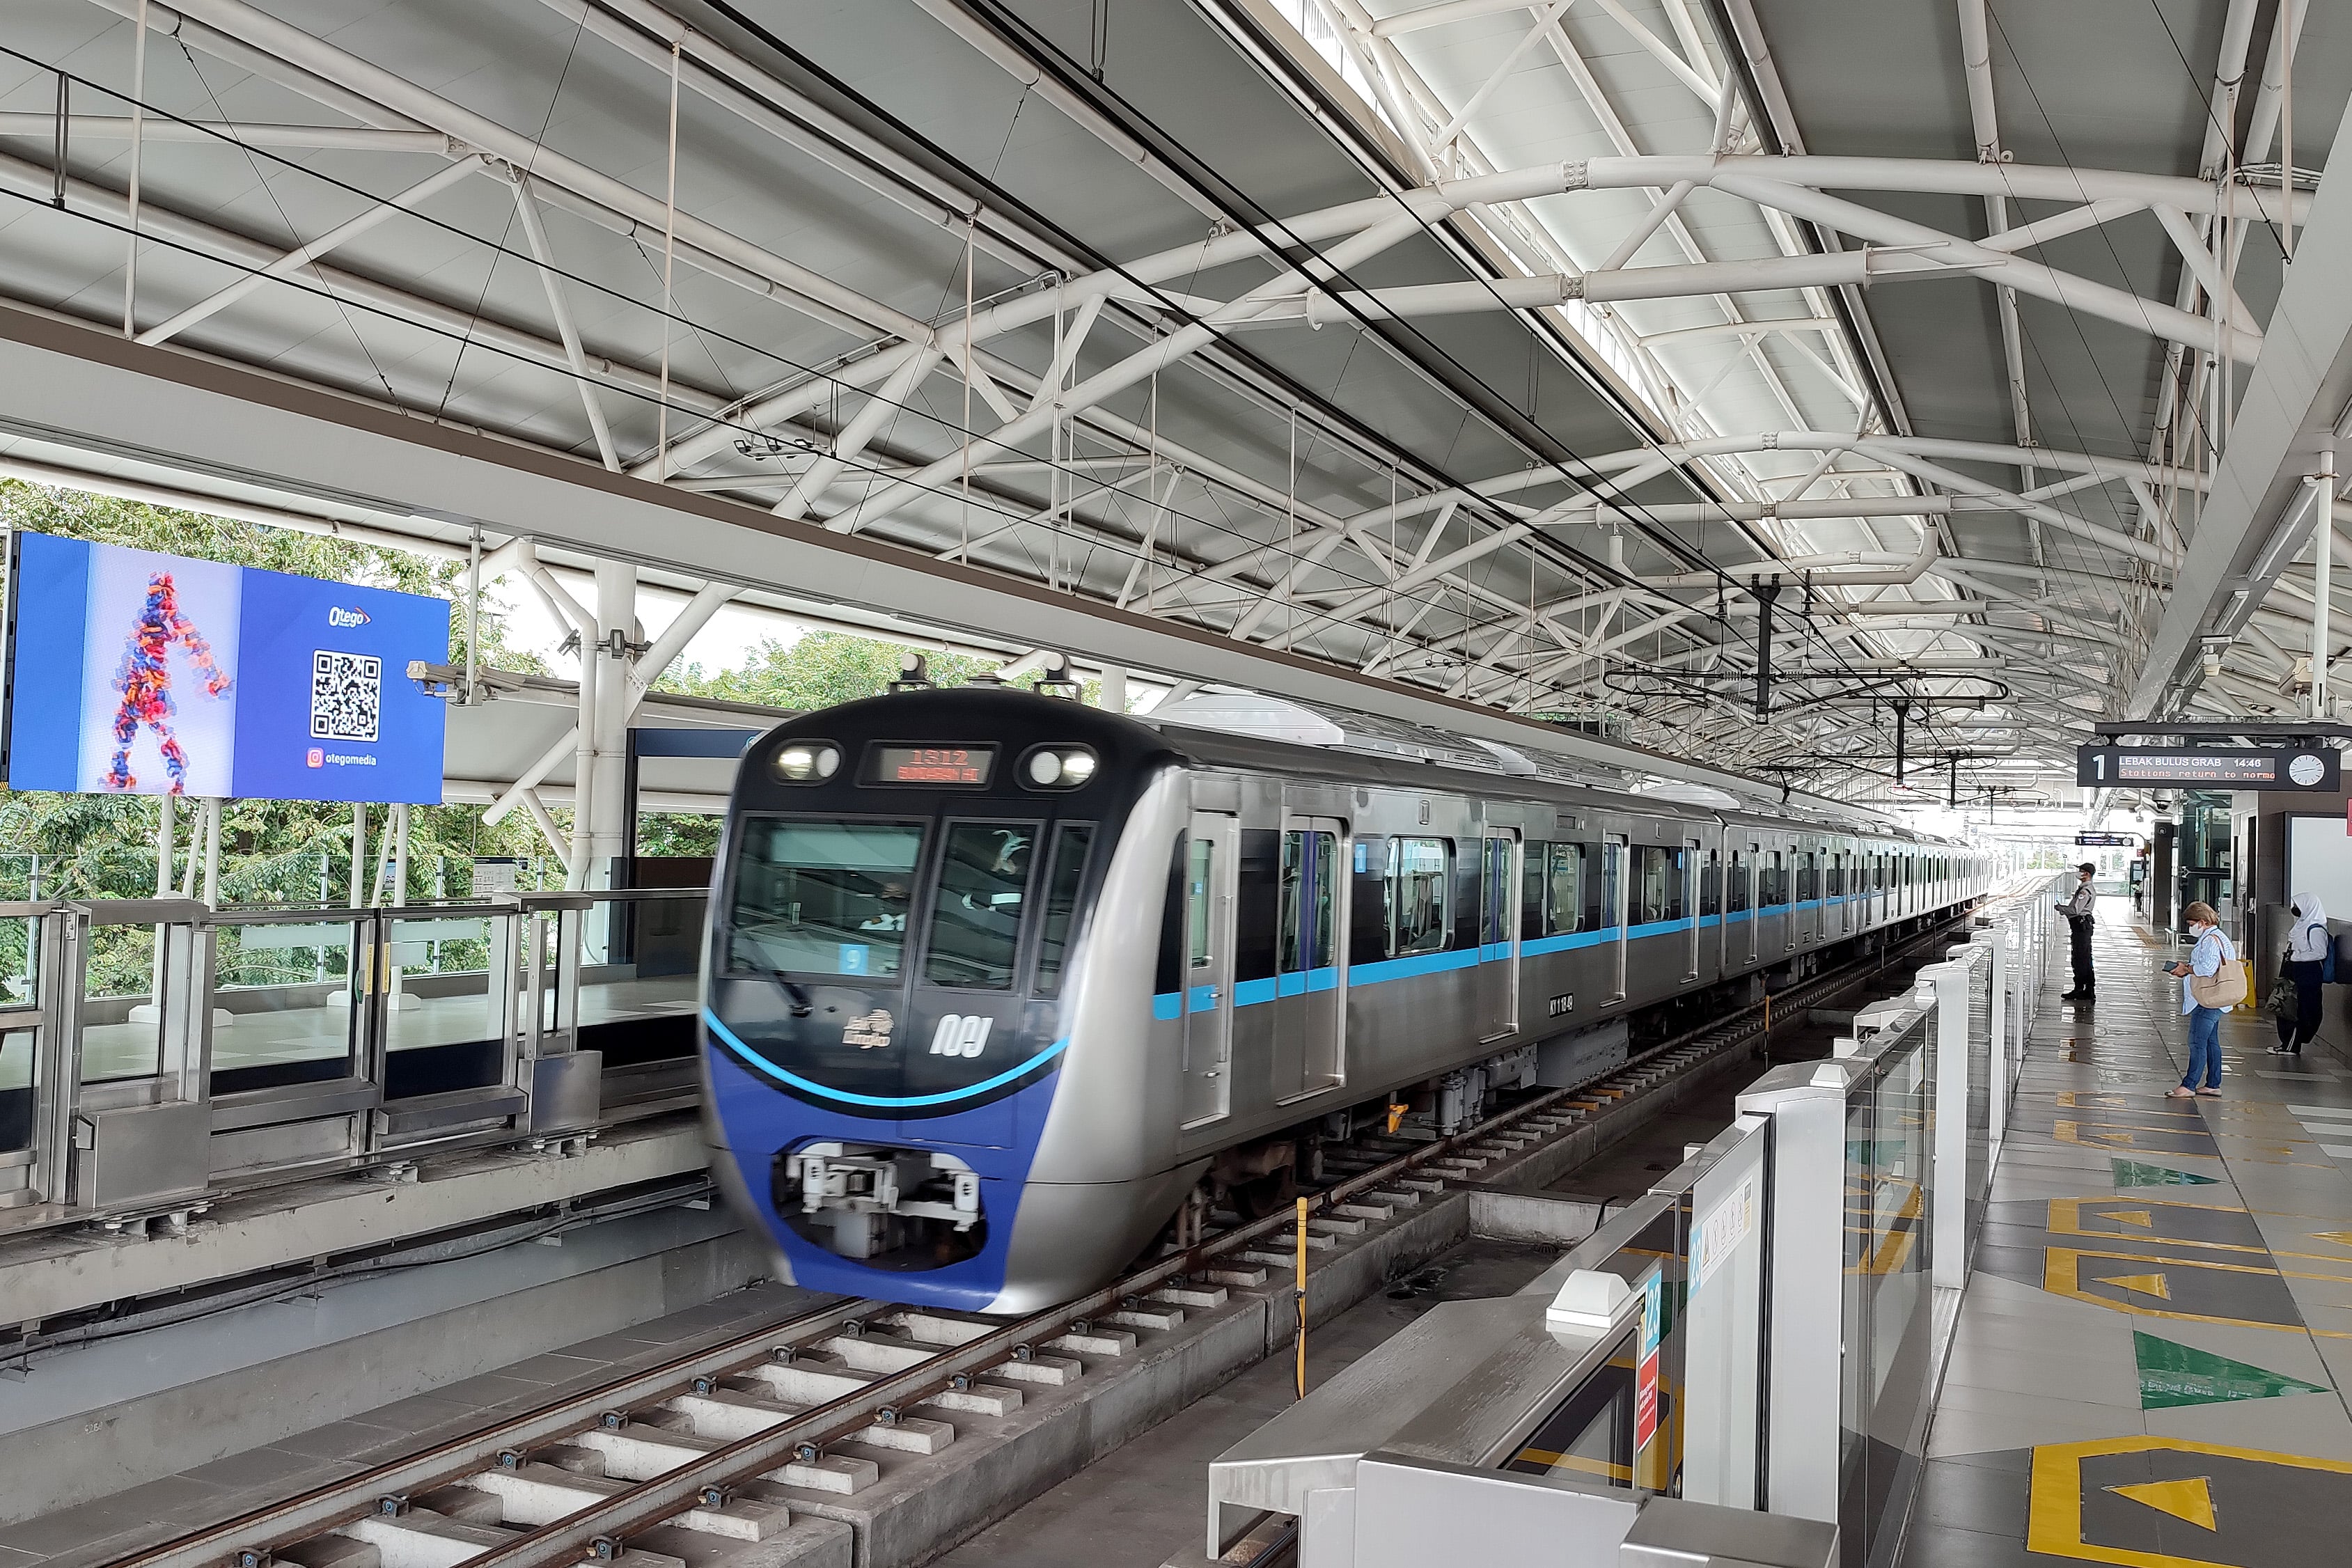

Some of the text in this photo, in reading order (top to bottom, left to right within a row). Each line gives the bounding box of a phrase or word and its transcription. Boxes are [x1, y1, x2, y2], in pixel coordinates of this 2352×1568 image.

[329, 606, 364, 628] Otego
[325, 753, 377, 767] otegomedia
[2092, 754, 2105, 780] 1
[2119, 757, 2153, 766] LEBAK
[2155, 758, 2189, 767] BULUS
[2191, 758, 2222, 767] GRAB
[2121, 768, 2171, 777] Stations
[2178, 769, 2216, 778] return
[1690, 1237, 1701, 1290] 23
[1646, 1283, 1660, 1343] 23
